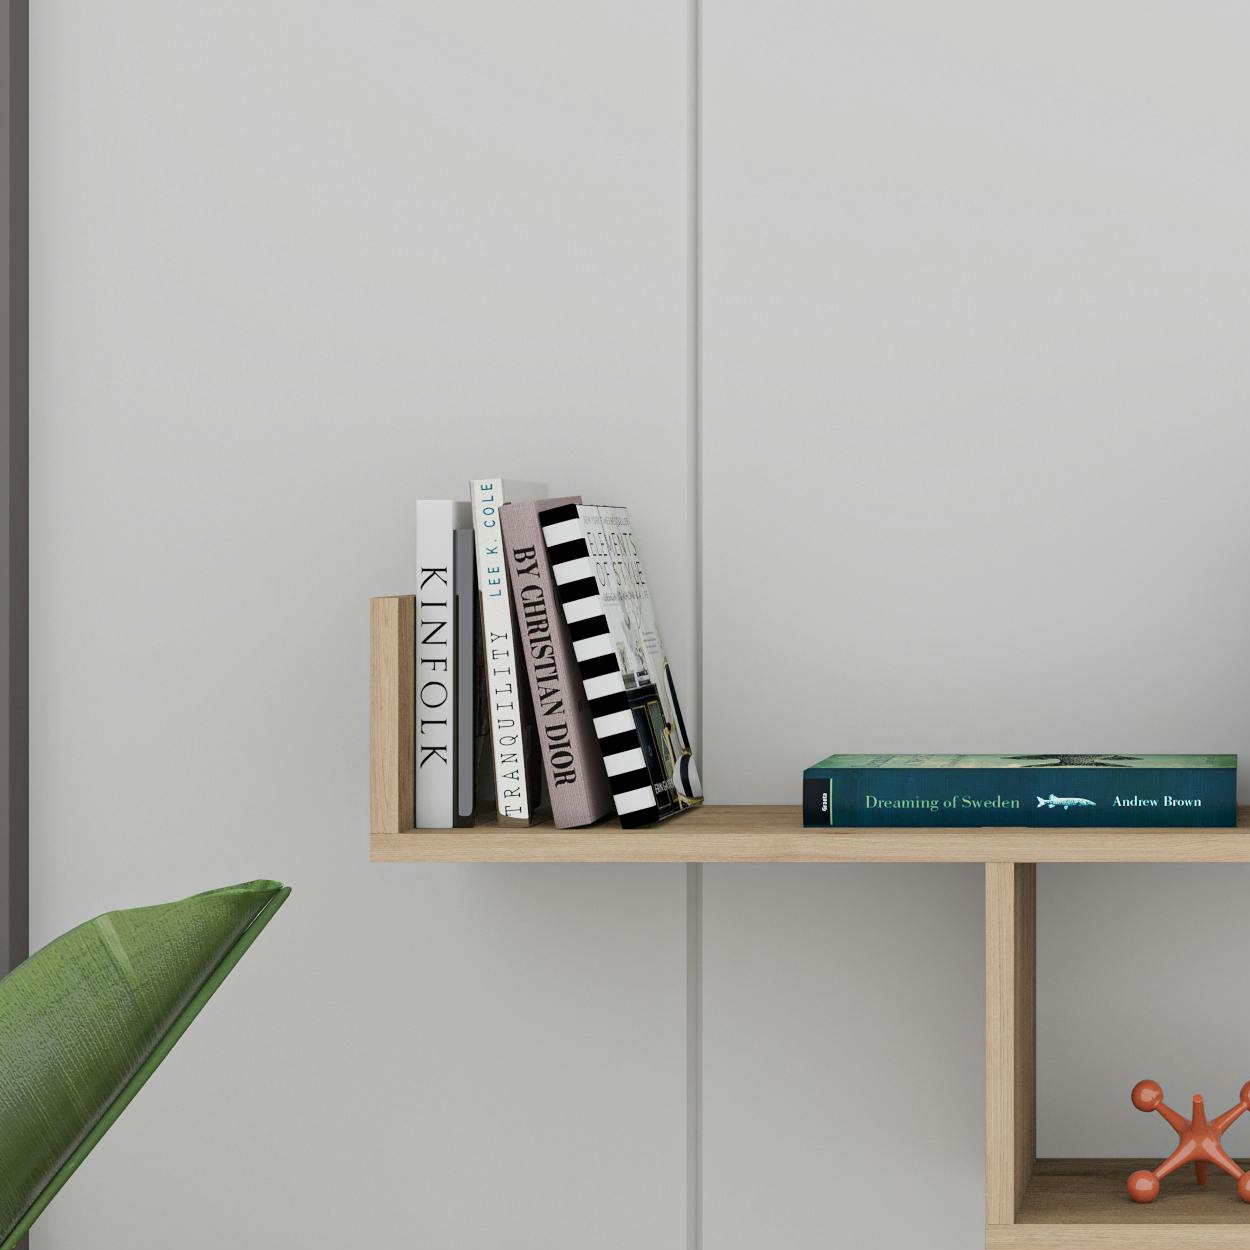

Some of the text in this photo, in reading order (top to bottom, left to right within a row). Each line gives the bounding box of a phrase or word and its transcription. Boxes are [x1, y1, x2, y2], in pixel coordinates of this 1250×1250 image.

[420, 566, 448, 769] KINFOLK
[480, 483, 522, 817] TRANQUILITY LEE K. COLE
[512, 544, 577, 788] BY CHRISTIAN DIOR
[865, 794, 1020, 812] Dreaming of Sweden
[1112, 795, 1203, 807] Andrew Brown
